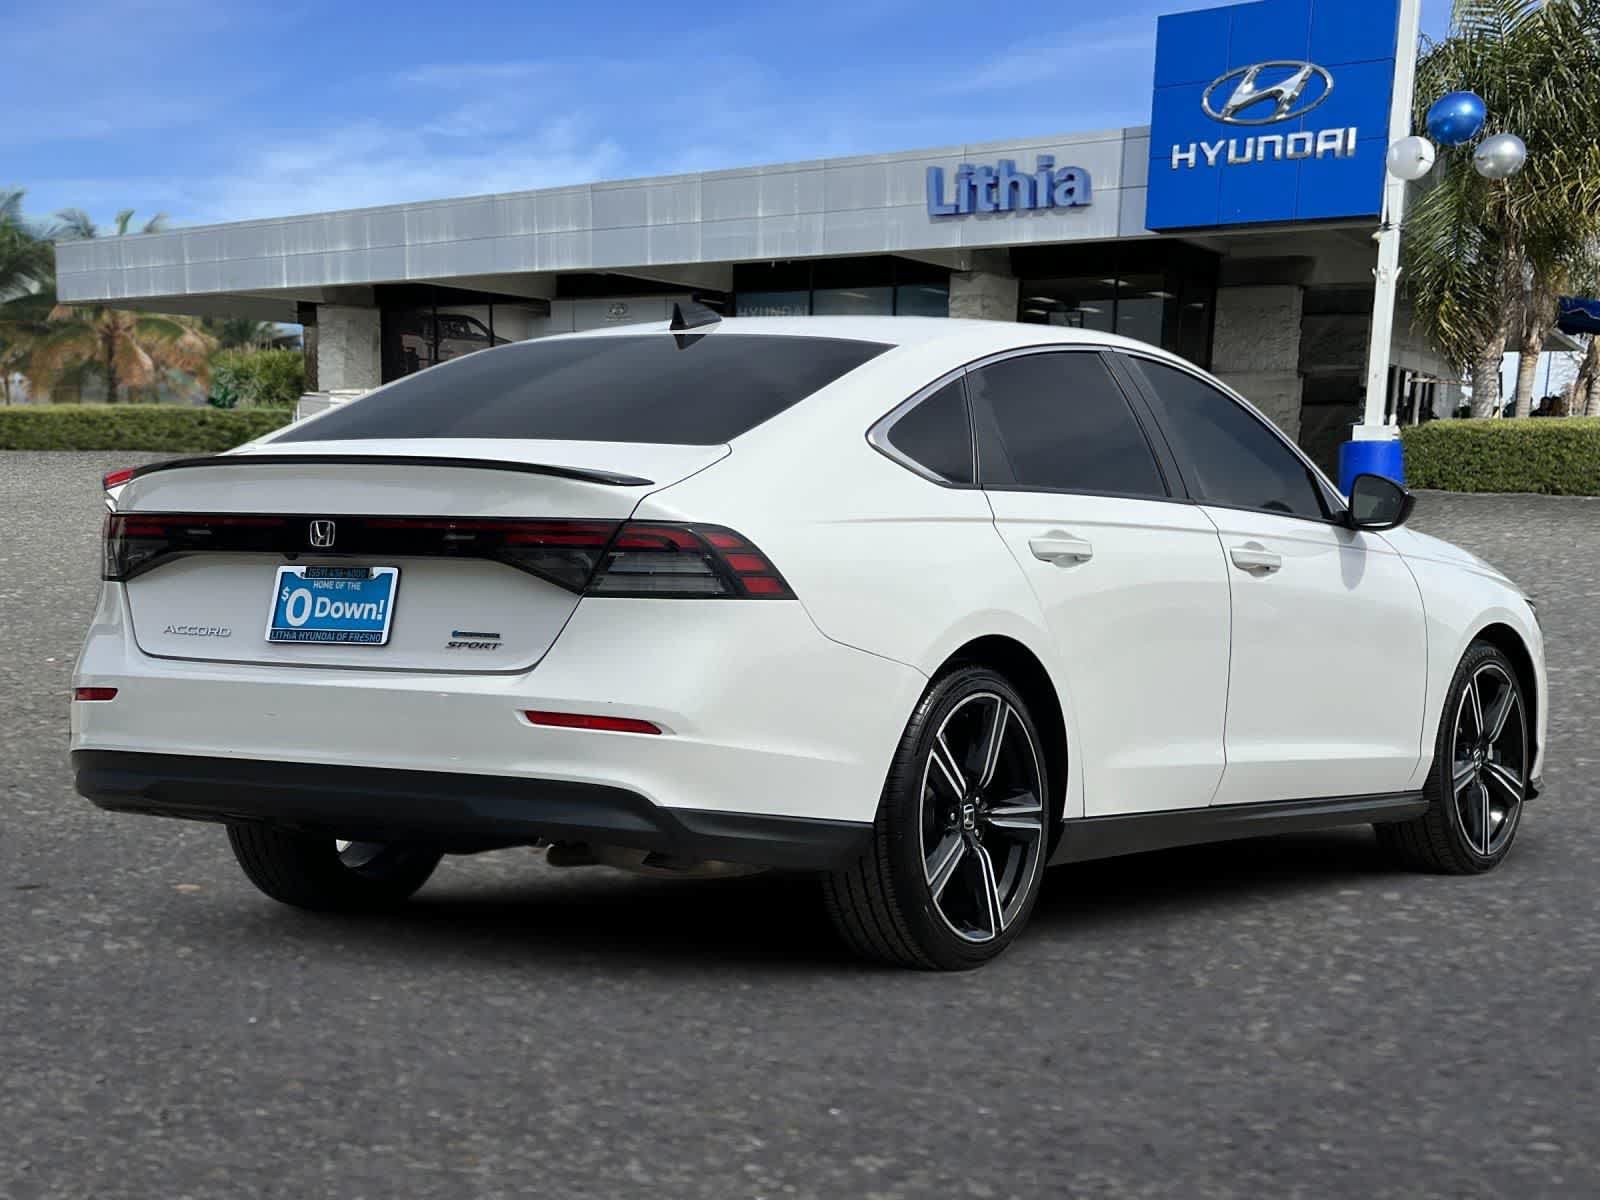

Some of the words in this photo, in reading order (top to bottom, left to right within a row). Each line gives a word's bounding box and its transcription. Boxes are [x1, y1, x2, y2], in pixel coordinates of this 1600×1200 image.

[1171, 126, 1357, 169] HYUNDAI
[926, 154, 1092, 218] Lithia
[313, 580, 334, 590] HOME
[335, 581, 345, 590] OF
[347, 581, 361, 591] THE
[314, 597, 385, 620] Down!
[163, 625, 232, 638] ACCORD
[335, 633, 348, 641] OF
[349, 633, 381, 642] FRESNO
[445, 641, 504, 651] SPORT
